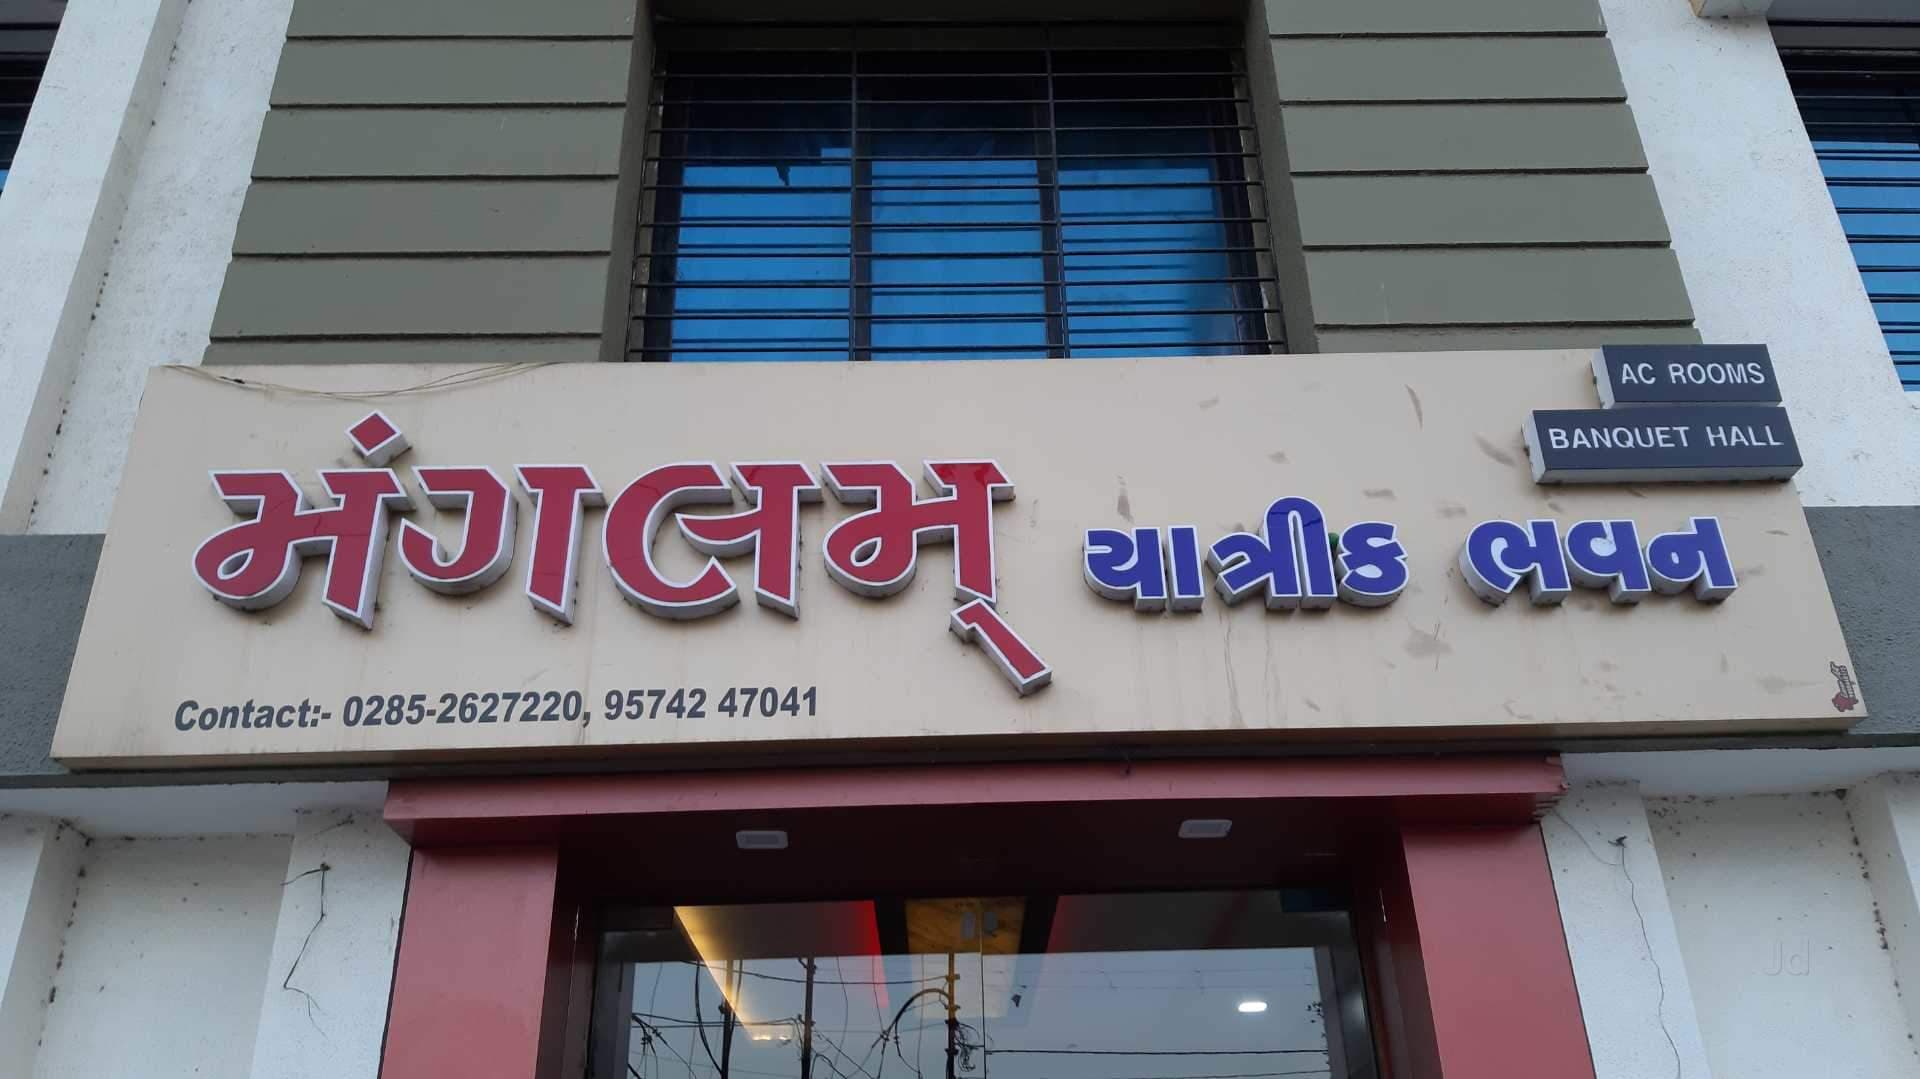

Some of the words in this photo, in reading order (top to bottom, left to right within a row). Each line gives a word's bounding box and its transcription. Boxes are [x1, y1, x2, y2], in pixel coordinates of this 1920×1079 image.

[1621, 362, 1656, 385] AC
[1668, 361, 1766, 385] ROOMS
[1549, 426, 1690, 450] BANQUET
[1706, 425, 1785, 447] HALL
[194, 410, 1052, 693] મંગલમ્
[1084, 496, 1408, 602] યાત્રીક
[1464, 516, 1738, 601] ભવન
[174, 699, 332, 731] Contact:-
[343, 692, 592, 728] 0285-2627220,
[604, 688, 707, 719] 95742
[717, 687, 817, 717] 47041
